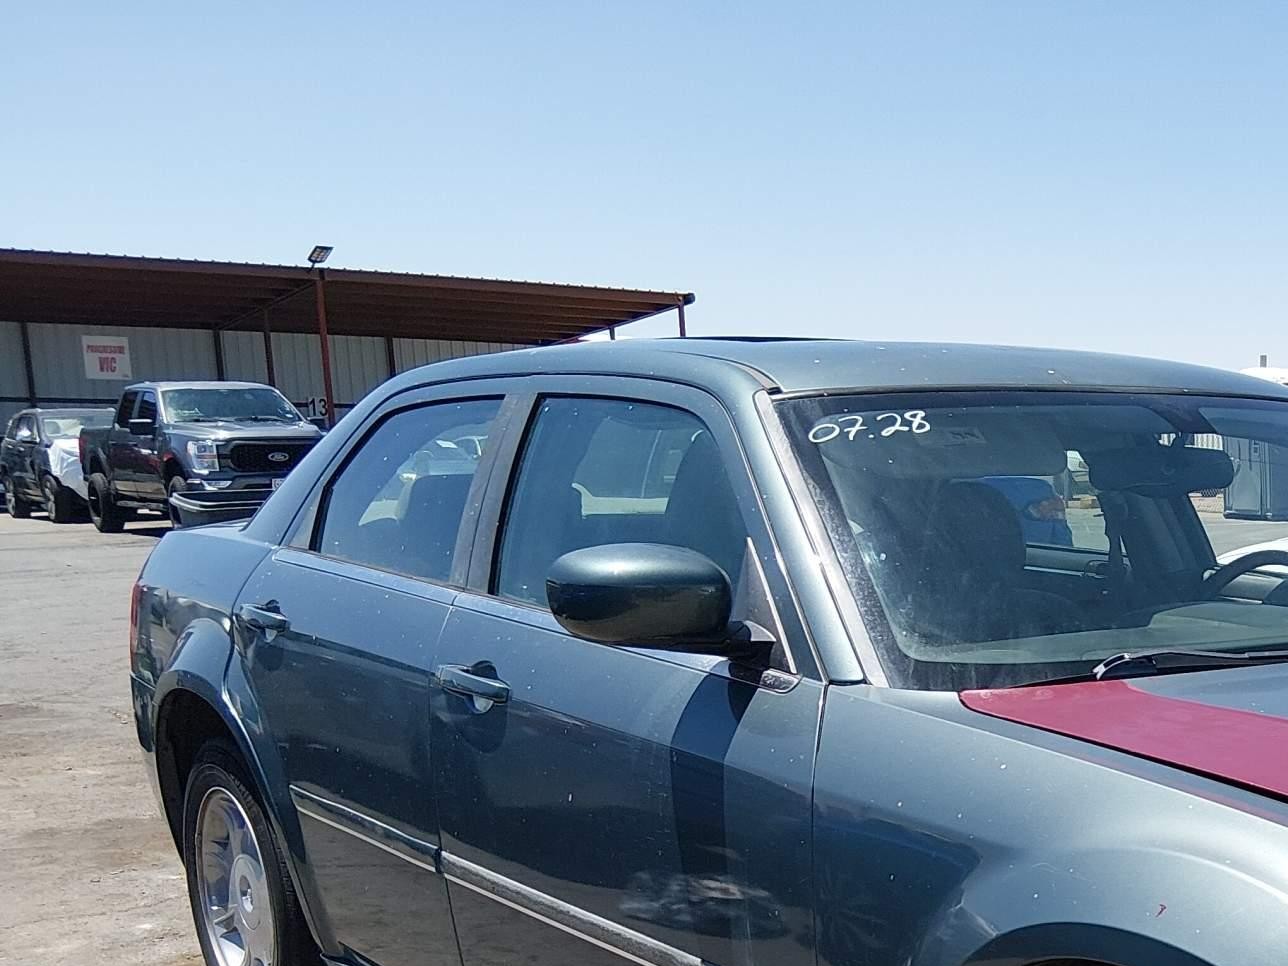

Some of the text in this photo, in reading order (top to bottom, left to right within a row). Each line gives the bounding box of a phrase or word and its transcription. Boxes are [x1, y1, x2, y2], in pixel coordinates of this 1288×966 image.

[99, 356, 117, 373] VIC
[308, 397, 329, 417] 13
[808, 410, 931, 443] 07.28
